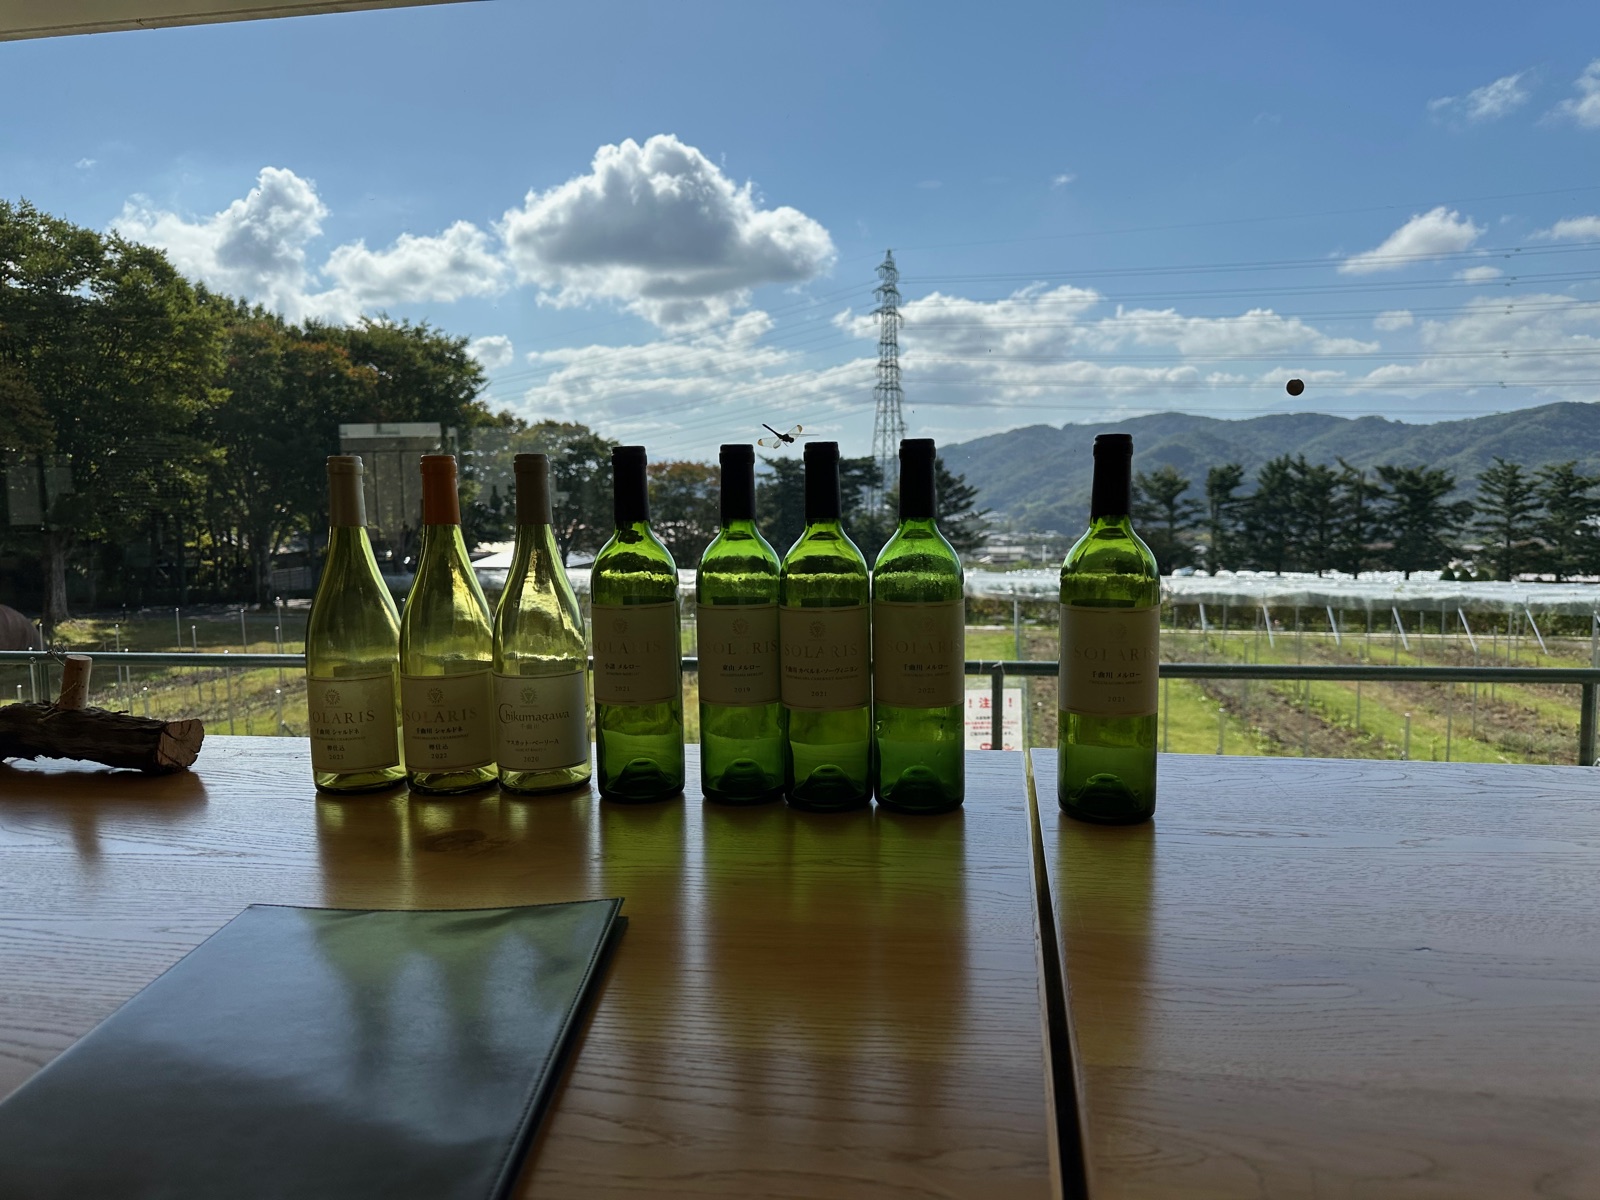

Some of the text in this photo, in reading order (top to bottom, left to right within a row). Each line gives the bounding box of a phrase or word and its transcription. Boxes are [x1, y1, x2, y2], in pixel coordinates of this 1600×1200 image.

[705, 639, 778, 655] SOLRIS
[784, 643, 857, 659] SOLARIS
[1116, 671, 1141, 679] メルロー
[309, 709, 375, 725] OLARIS
[405, 707, 478, 724] SOLARIS
[498, 702, 571, 724] Chikumagawa
[331, 727, 361, 736] シャルドネ
[434, 725, 464, 735] シャルドネ
